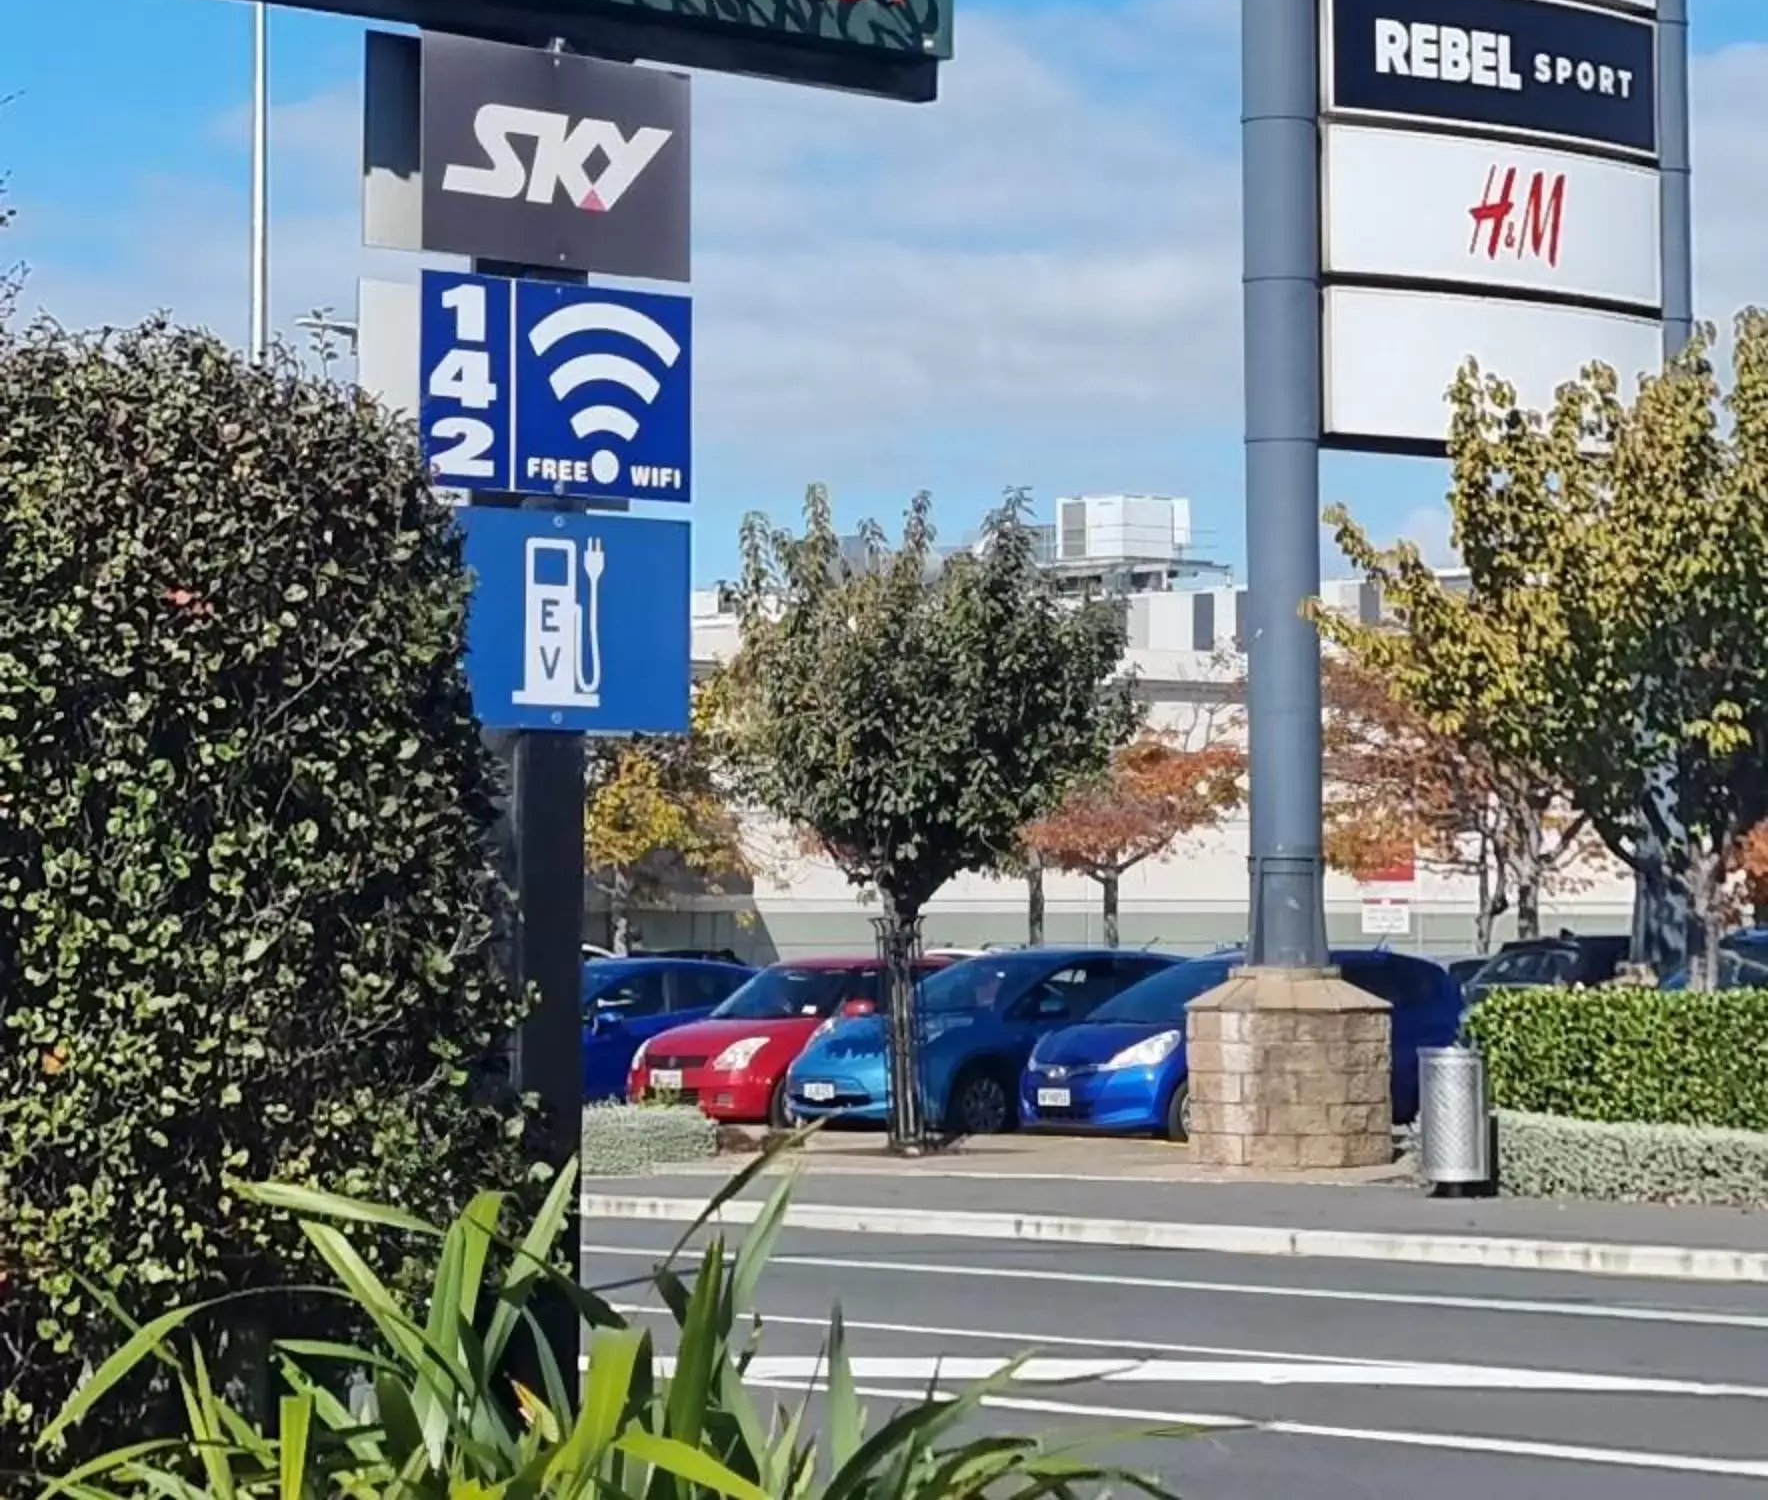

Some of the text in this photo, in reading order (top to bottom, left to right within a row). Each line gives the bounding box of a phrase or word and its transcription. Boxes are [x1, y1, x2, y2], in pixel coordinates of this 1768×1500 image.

[1375, 18, 1633, 99] REBEL SPORT
[441, 103, 673, 212] SKY
[1468, 163, 1566, 269] H&M
[527, 457, 682, 489] FREE WIFI
